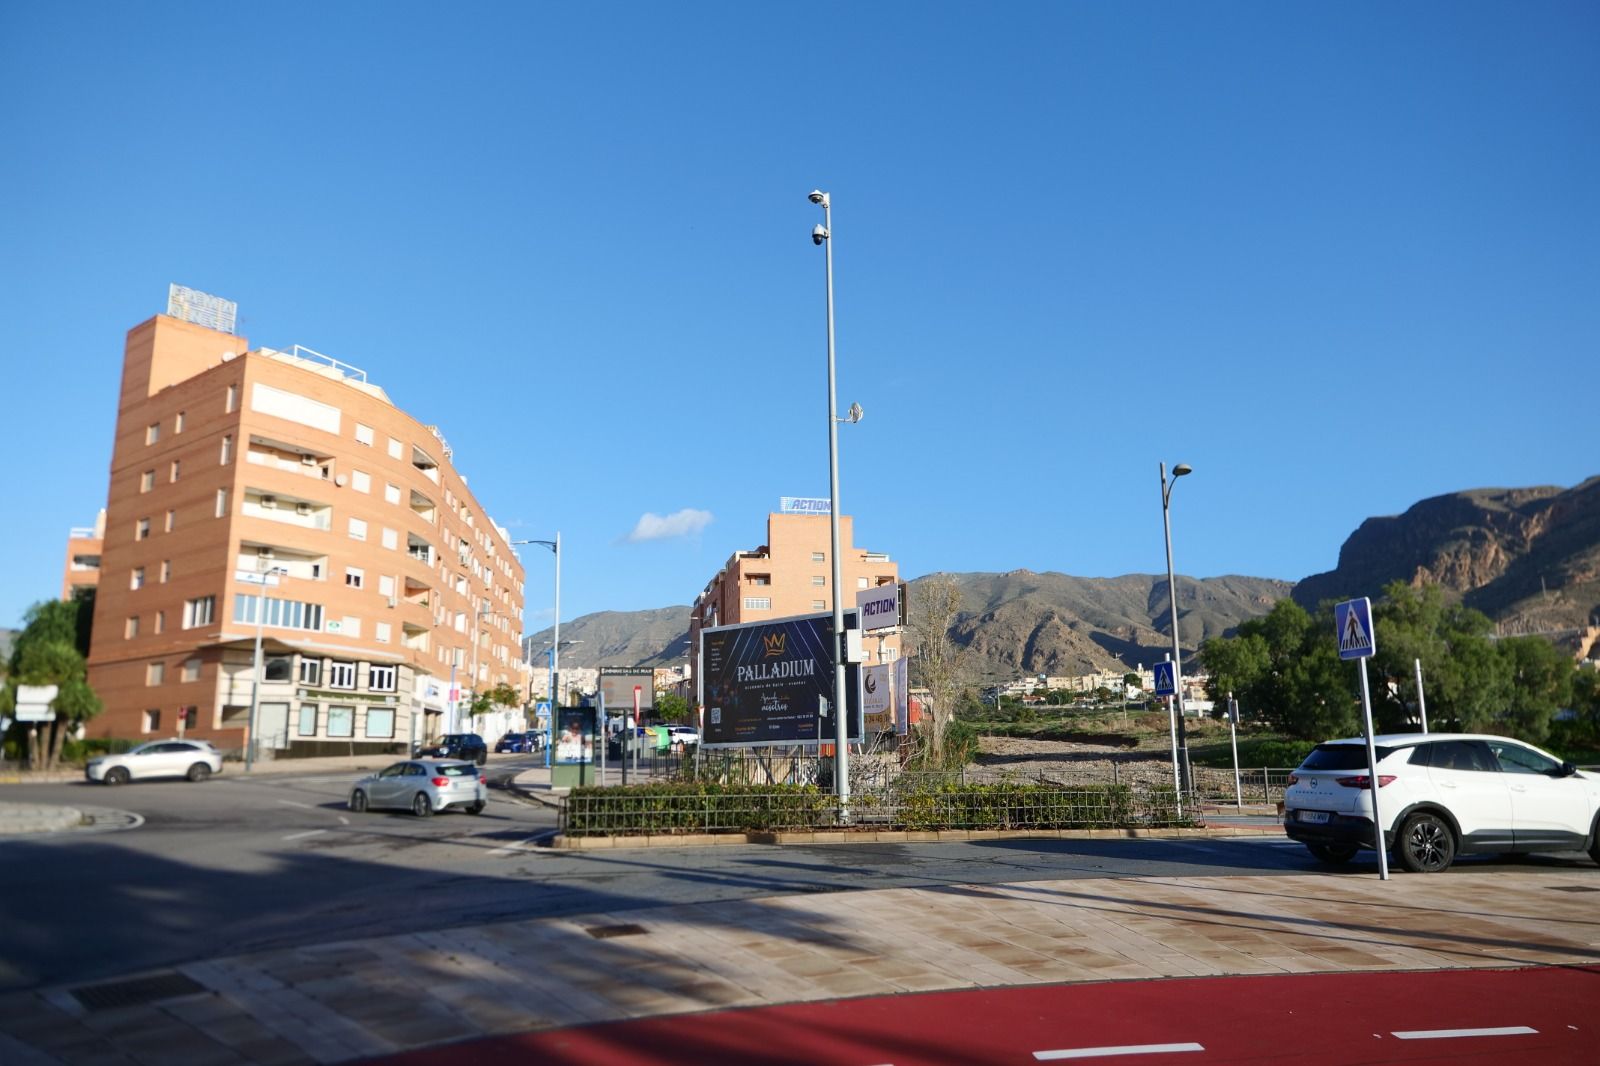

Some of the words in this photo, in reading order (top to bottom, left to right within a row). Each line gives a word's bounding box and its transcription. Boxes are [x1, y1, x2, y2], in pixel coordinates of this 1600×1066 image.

[791, 499, 831, 511] ACTION
[863, 597, 895, 617] ACTION
[737, 658, 814, 682] PALLADIUM
